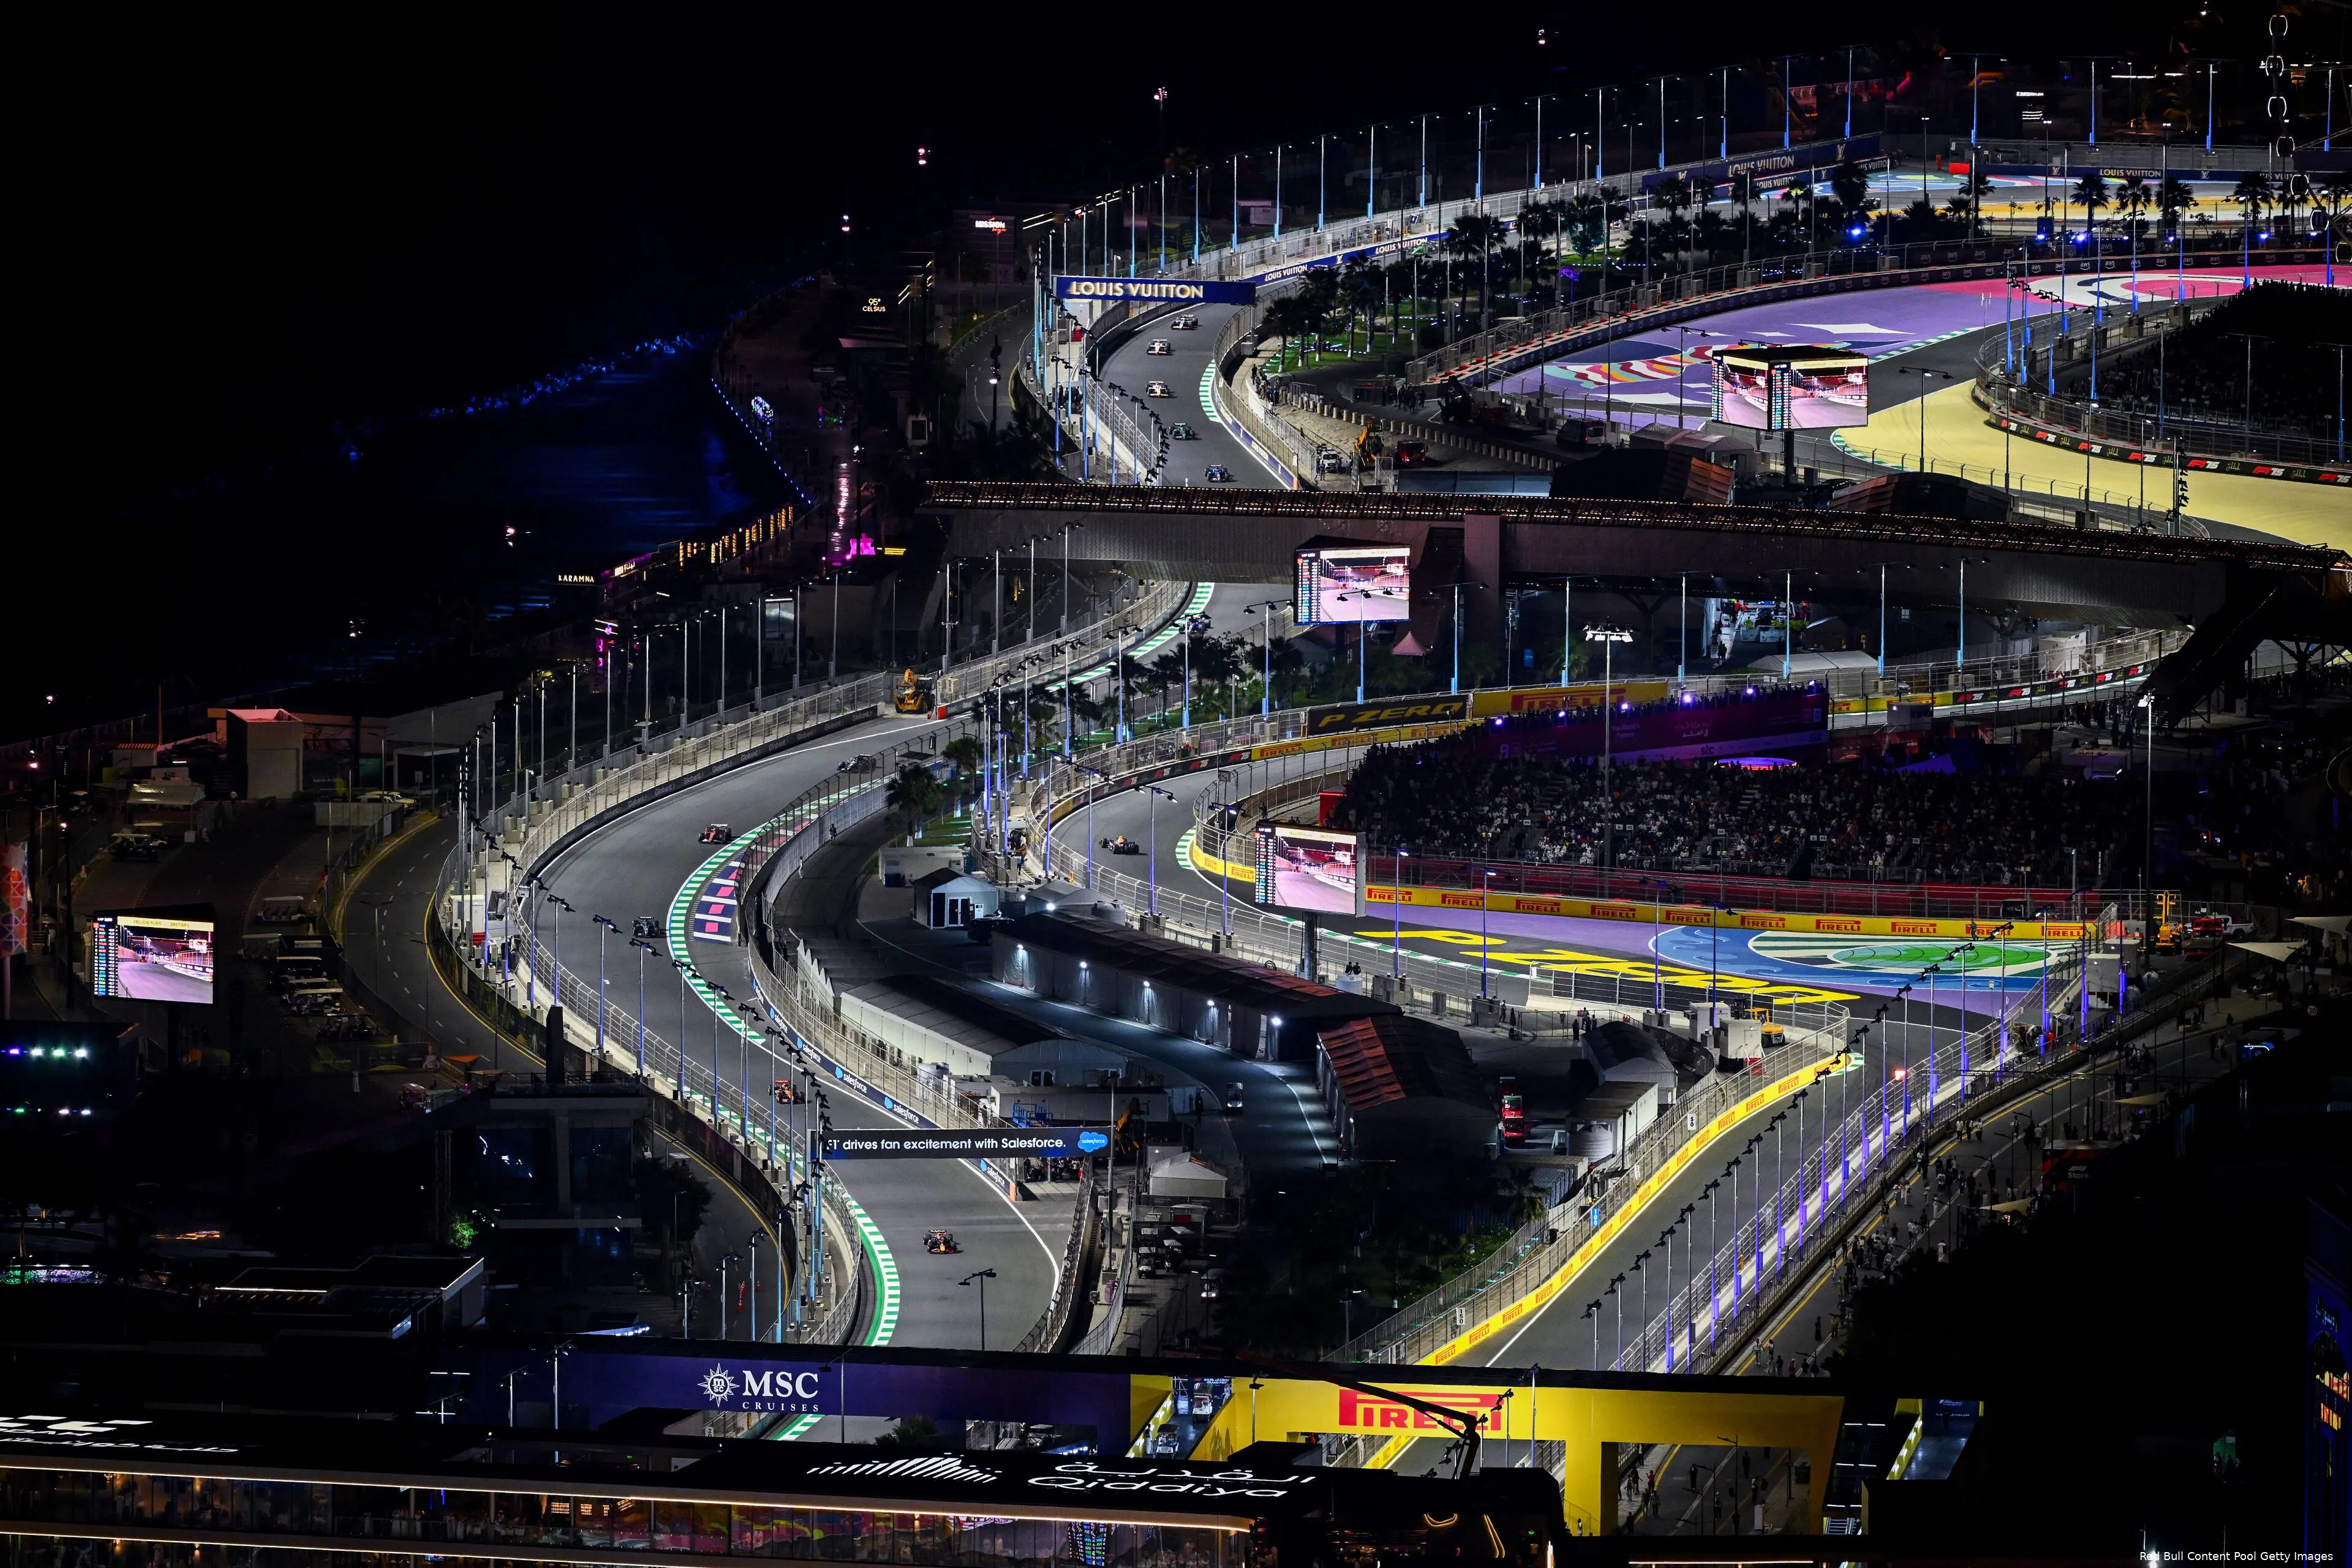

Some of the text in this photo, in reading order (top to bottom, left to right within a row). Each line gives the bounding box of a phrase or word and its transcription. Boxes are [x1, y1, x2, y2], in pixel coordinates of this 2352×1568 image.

[2100, 168, 2162, 178] LOUIS VUITTON
[1375, 243, 1396, 254] LOUIS
[1265, 264, 1308, 282] LOUIS VUITTON
[1069, 281, 1204, 299] LOUIS VUITTON
[1319, 702, 1464, 728] P ZERO
[1367, 888, 1412, 902] PIRELLI
[1515, 899, 1561, 913] PIRELLI
[1591, 905, 1636, 919] PIRELLI
[1665, 910, 1711, 924] PIRELLI
[1740, 915, 1785, 929] PIRELLI
[1815, 919, 1861, 932] PIRELLI
[1891, 922, 1937, 934] PIRELLI
[802, 1043, 821, 1063] salesforce
[843, 1073, 867, 1093] salesforce
[1779, 1075, 1799, 1094] PIRELLI
[1746, 1093, 1764, 1113] PIRELLI
[894, 1104, 919, 1124] salesforce
[1718, 1111, 1735, 1130] PIRELLI
[843, 1137, 878, 1150] drives
[880, 1137, 900, 1150] fan
[903, 1137, 973, 1150] excitement
[975, 1137, 998, 1148] with
[1001, 1137, 1066, 1149] Salesforce.
[1697, 1129, 1709, 1148] PIRELLI
[1536, 1283, 1553, 1303] PIRELLI
[1502, 1303, 1523, 1323] PIRELLI
[1469, 1323, 1490, 1344] PIRELLI
[1436, 1344, 1455, 1365] PIRELLI
[742, 1370, 818, 1398] MSC
[742, 1401, 818, 1412] CRUISES
[1339, 1389, 1504, 1431] PIRELLI
[1028, 1477, 1287, 1497] Qiddiya
